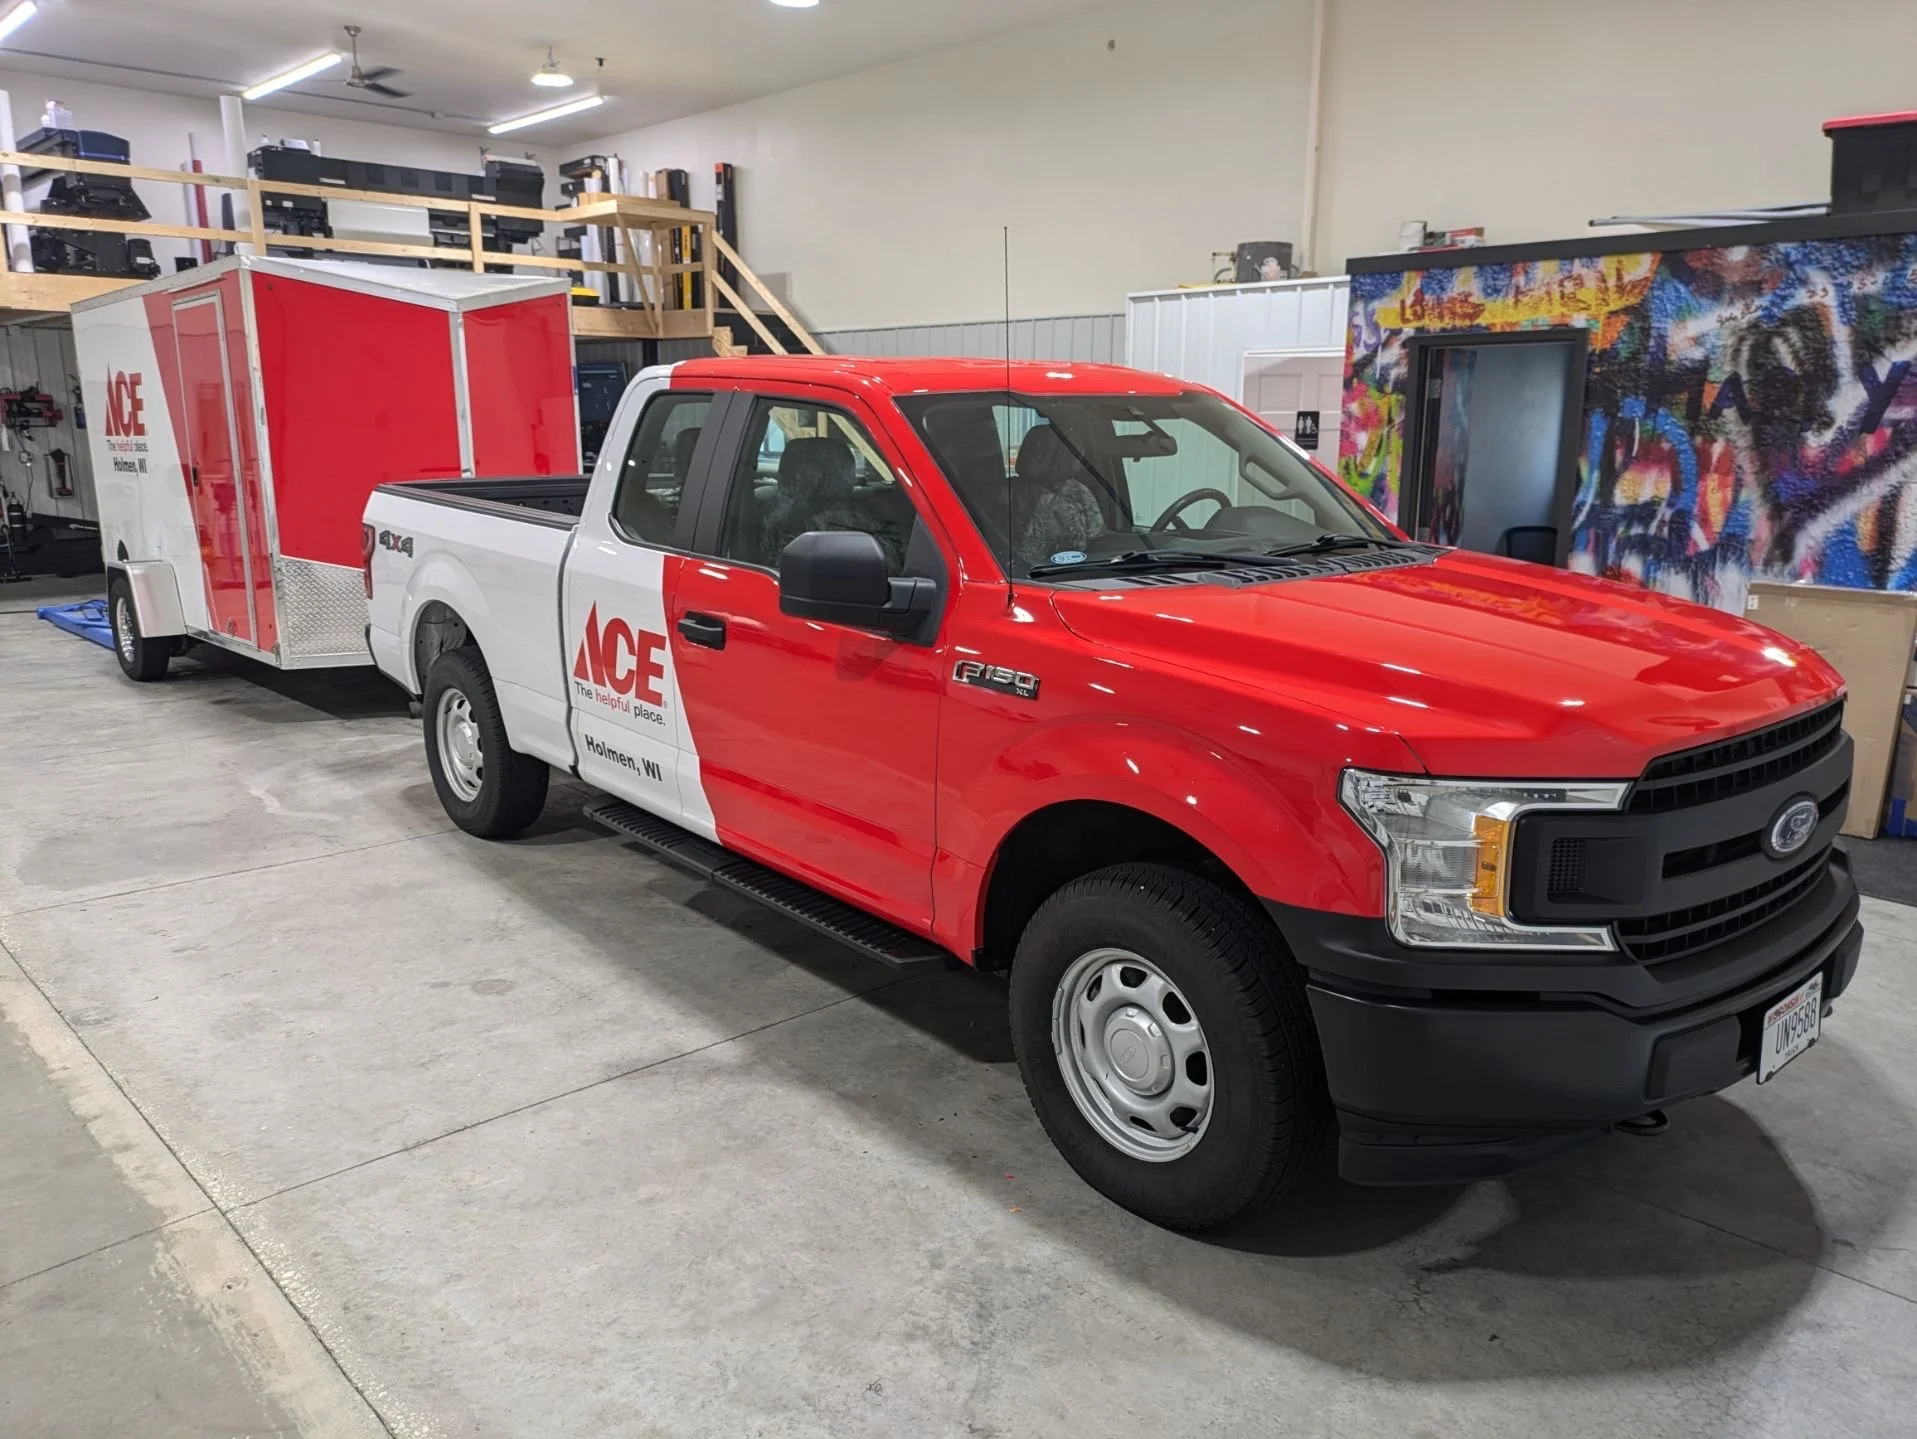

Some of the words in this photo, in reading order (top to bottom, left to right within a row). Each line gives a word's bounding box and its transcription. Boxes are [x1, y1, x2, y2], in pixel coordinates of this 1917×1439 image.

[105, 361, 145, 438] ACE
[573, 599, 667, 708] ACE
[574, 680, 593, 700] The
[595, 689, 631, 713] helpful
[633, 704, 666, 726] place.
[1015, 687, 1029, 697] XL
[584, 733, 642, 777] Holmen,
[641, 757, 663, 782] WI
[1775, 996, 1817, 1055] UN9588
